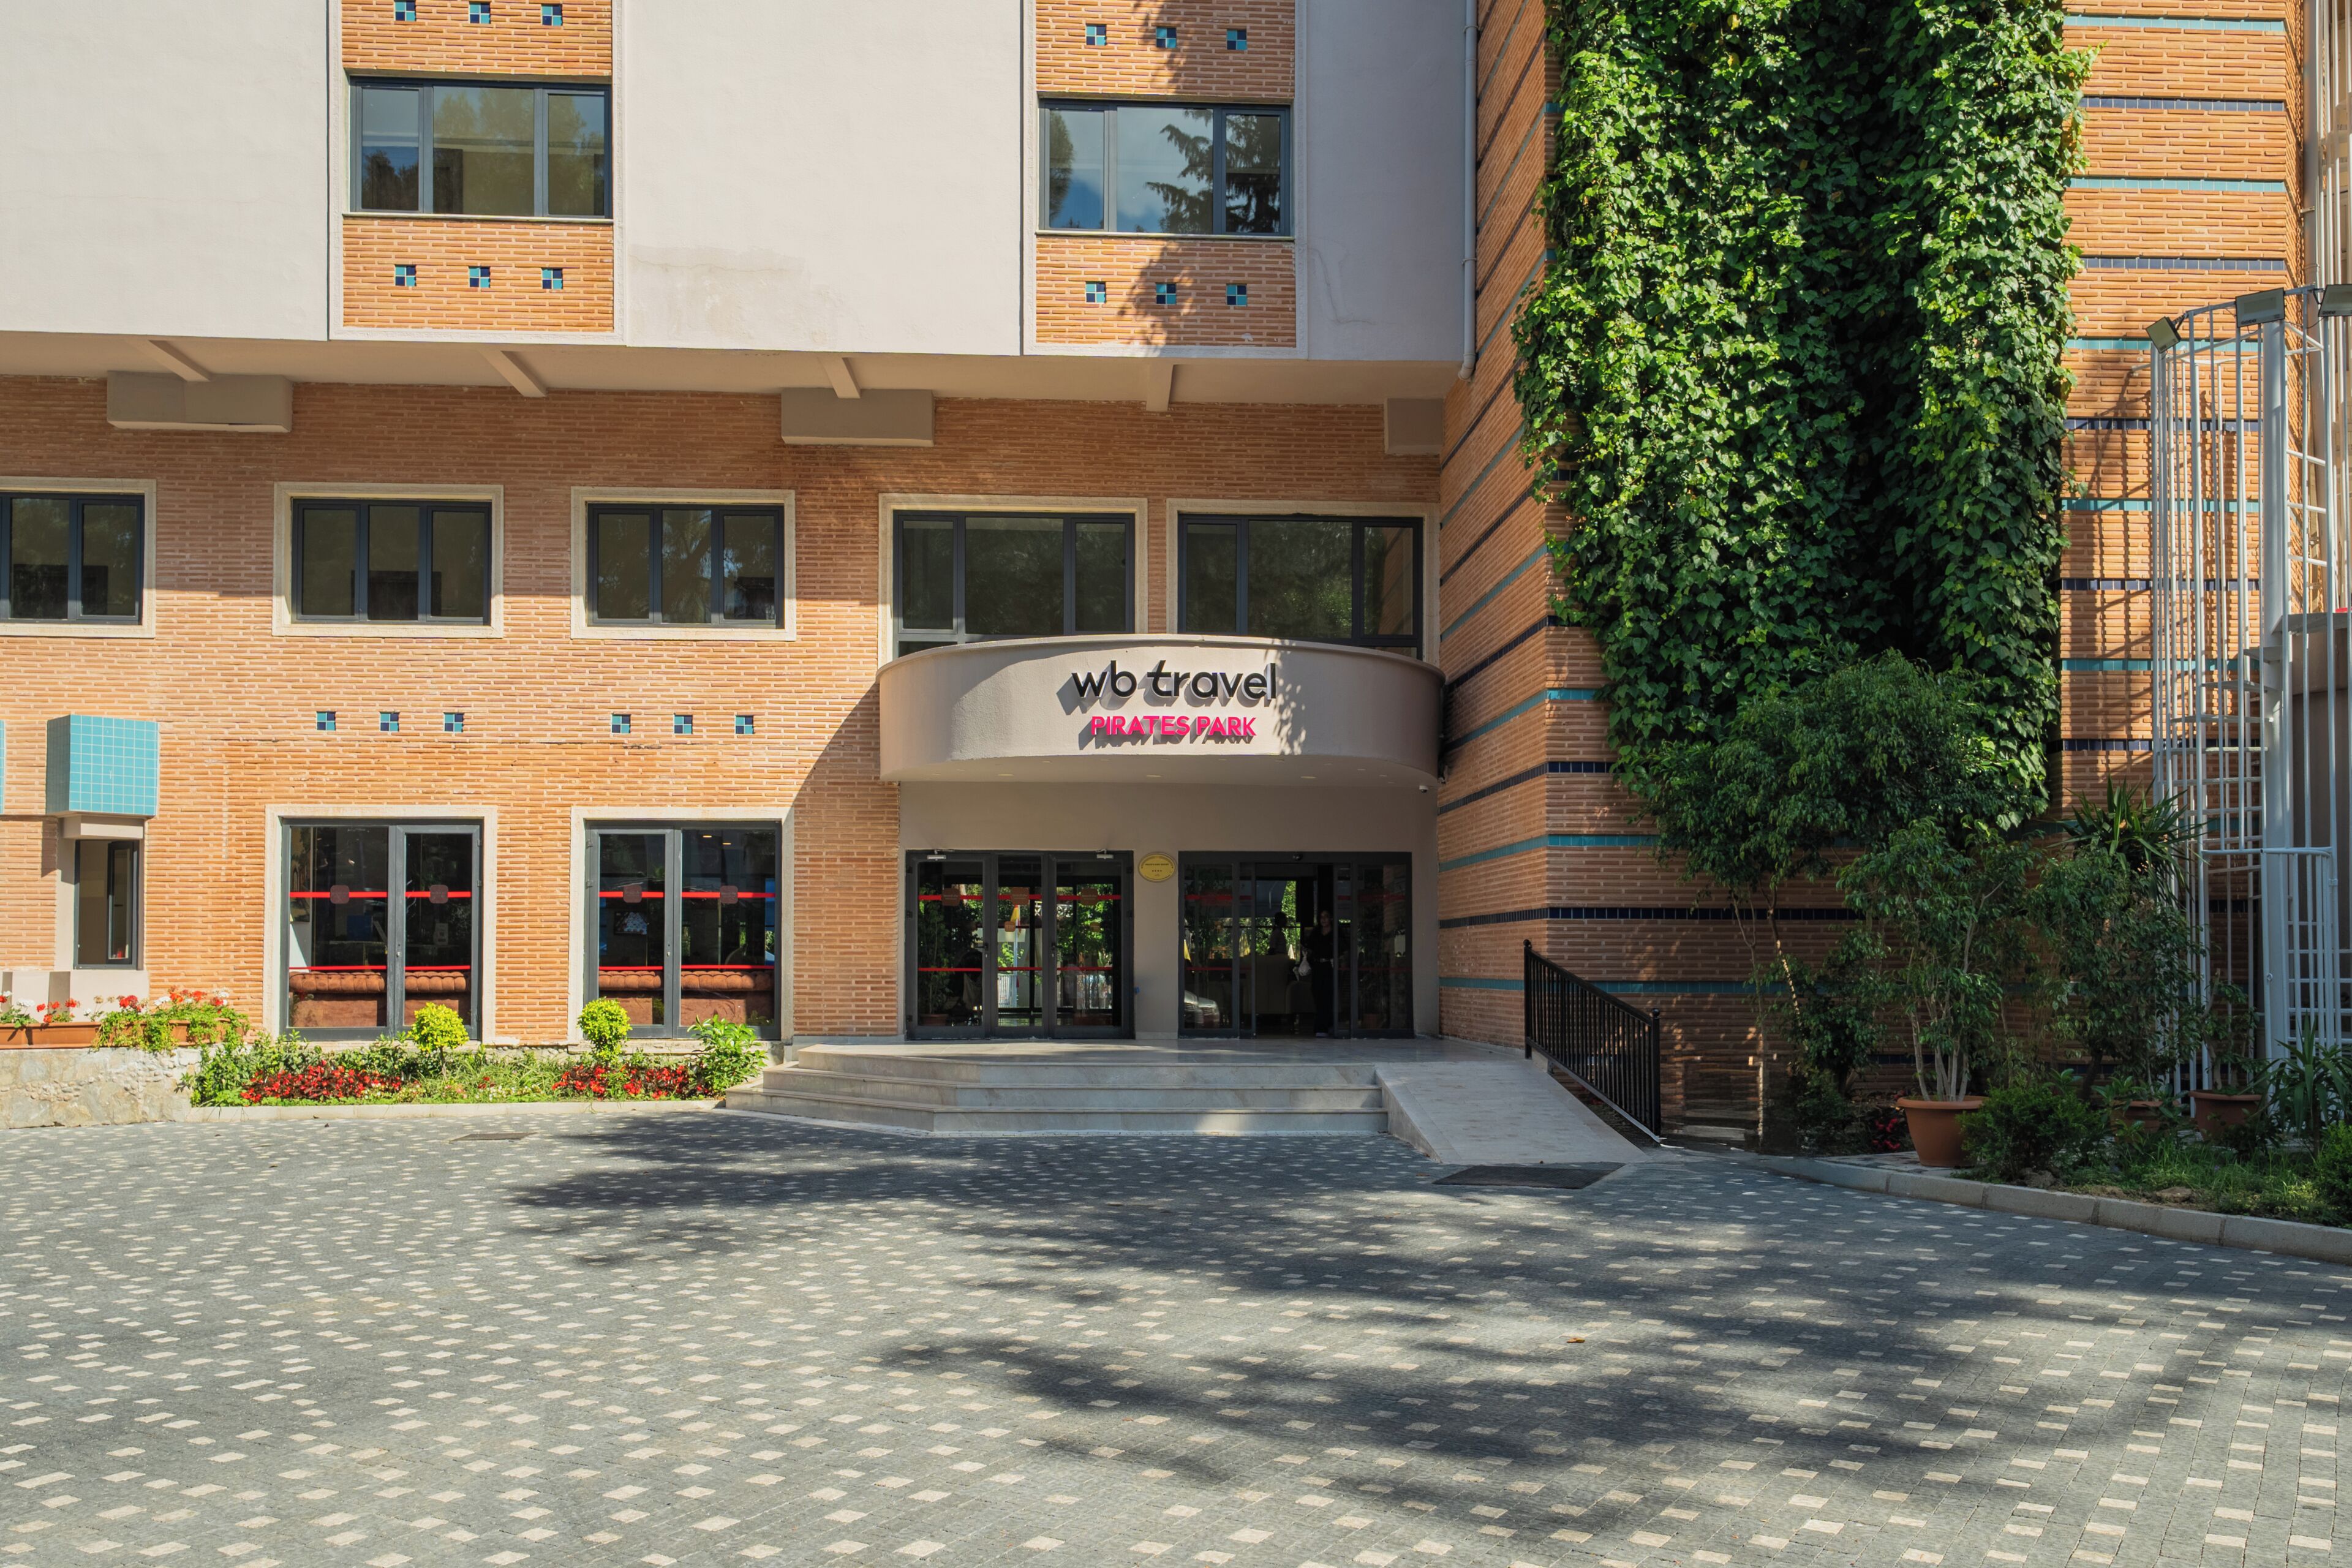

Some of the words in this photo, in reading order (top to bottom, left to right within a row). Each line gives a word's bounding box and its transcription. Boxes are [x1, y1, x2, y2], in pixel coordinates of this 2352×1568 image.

[1071, 660, 1137, 698] wb
[1147, 660, 1276, 700] travel
[1091, 715, 1191, 736] PIRATES
[1196, 716, 1257, 736] PARK
